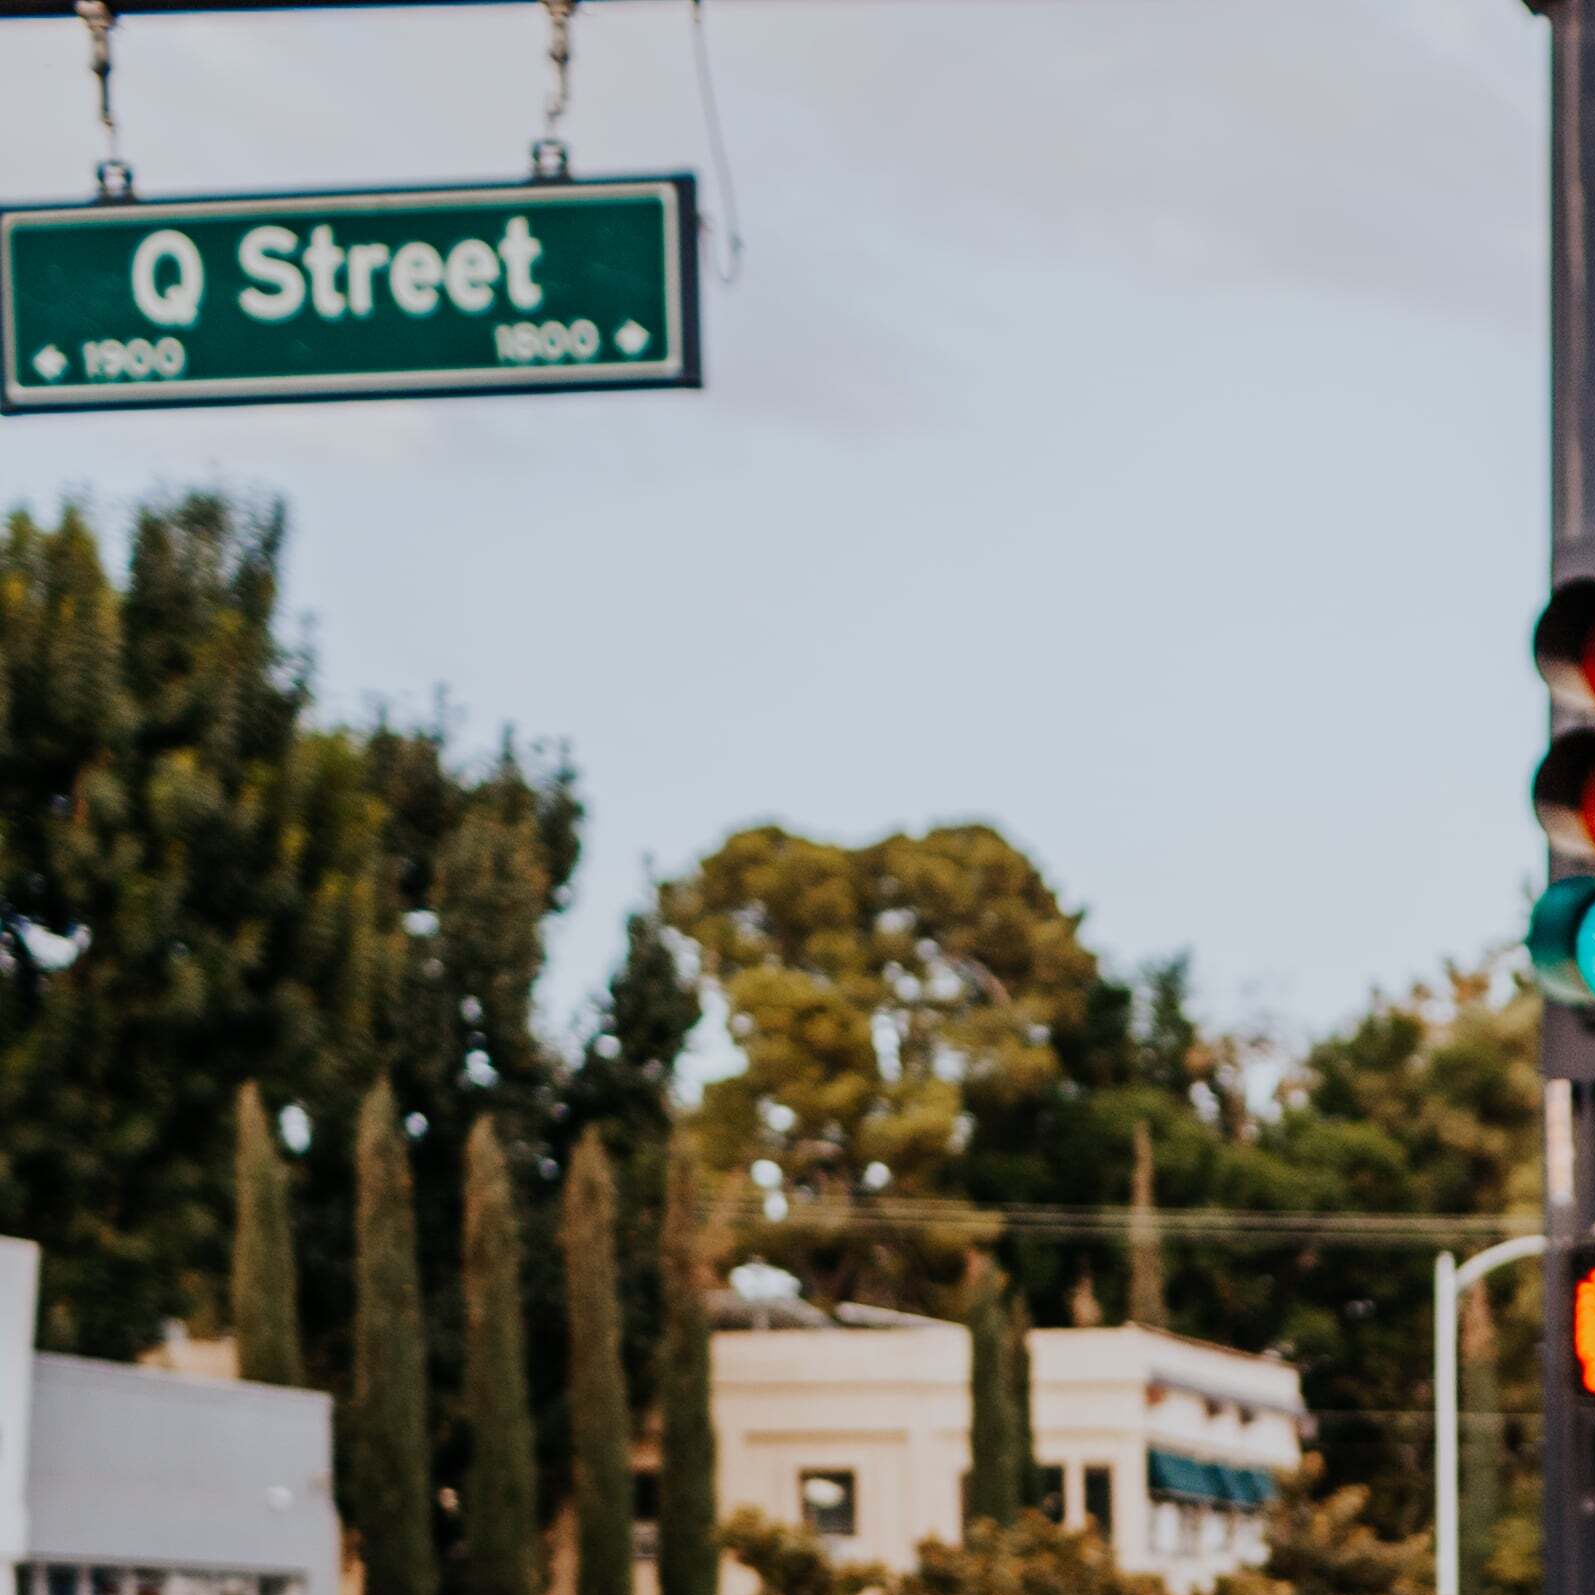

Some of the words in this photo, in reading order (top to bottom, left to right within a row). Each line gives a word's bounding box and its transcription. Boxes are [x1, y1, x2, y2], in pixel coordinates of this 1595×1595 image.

[131, 229, 203, 327] Q
[237, 216, 543, 321] Street
[82, 336, 186, 379] 1900
